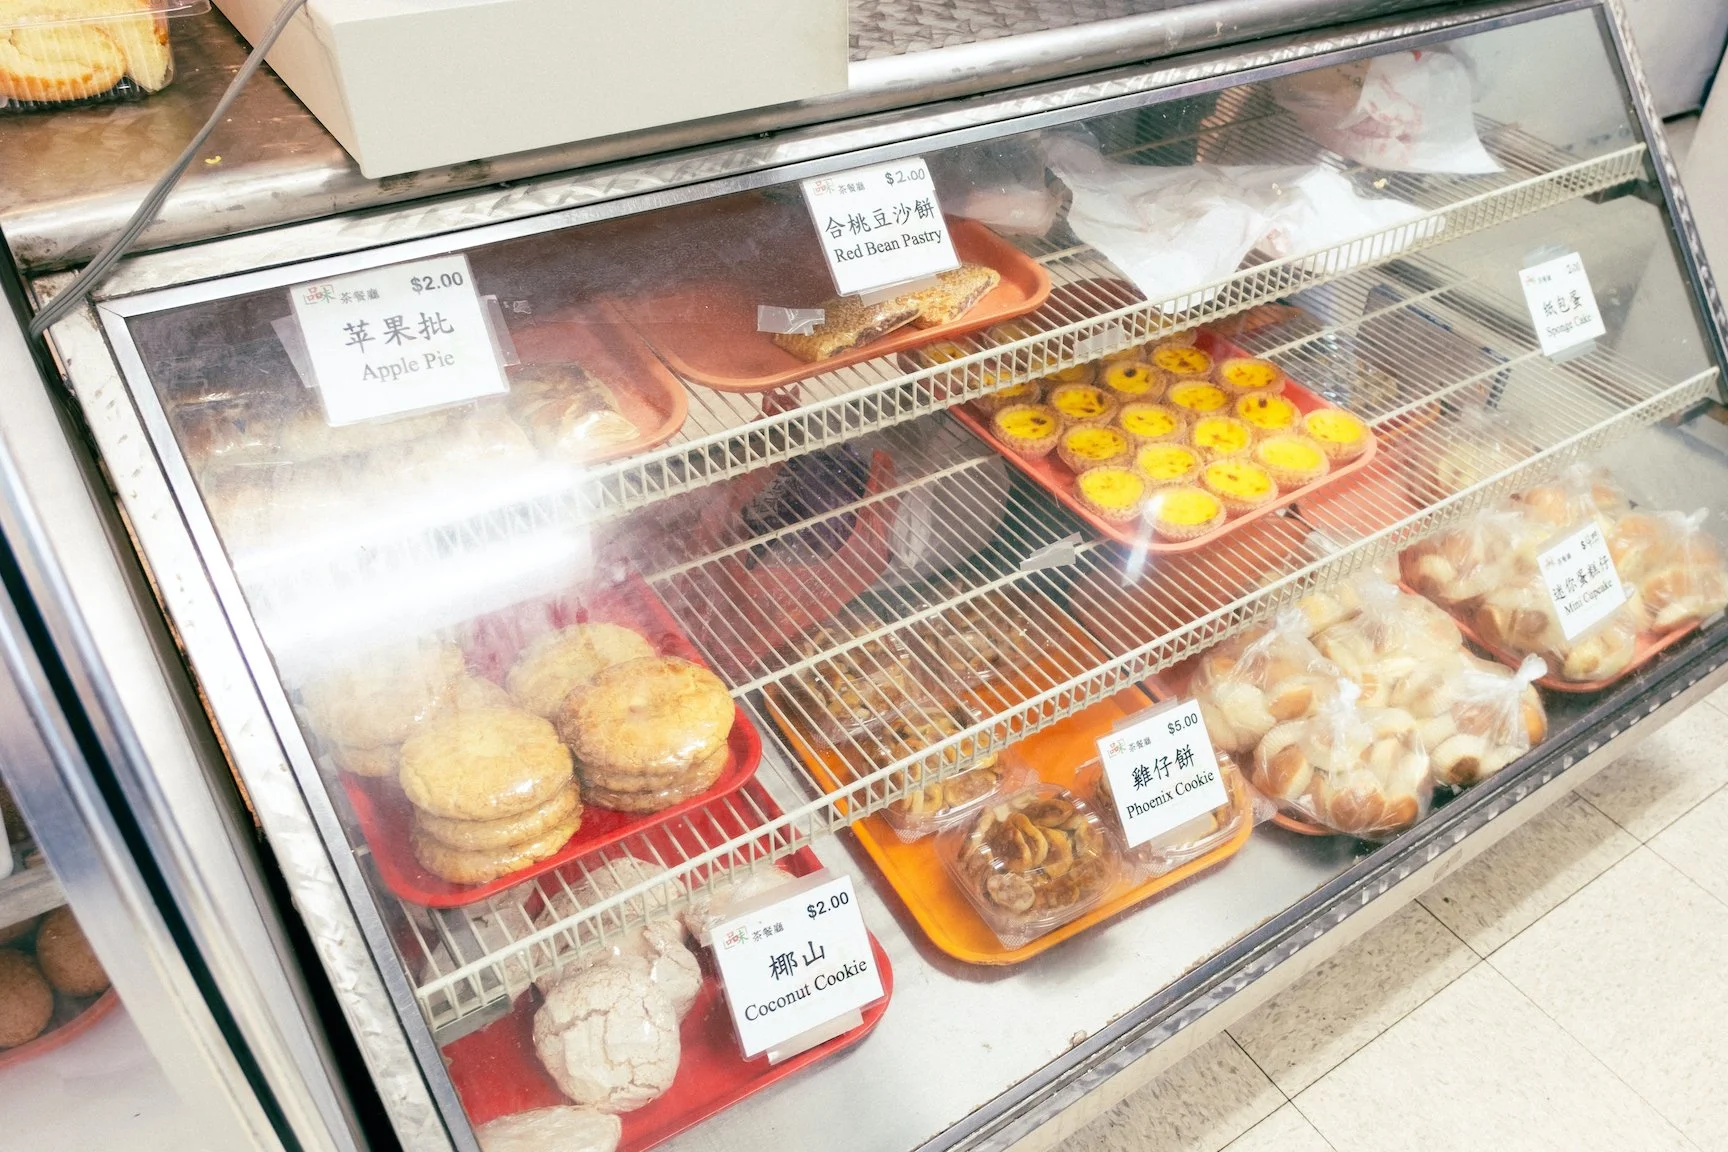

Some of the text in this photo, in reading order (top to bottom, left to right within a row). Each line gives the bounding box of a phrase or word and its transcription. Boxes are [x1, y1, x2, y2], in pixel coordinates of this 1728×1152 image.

[884, 168, 925, 186] $2.00
[825, 197, 935, 240] 合桃豆沙餅
[834, 229, 942, 263] Red Bean Pastry
[410, 271, 463, 295] $2.00
[342, 311, 455, 353] 苹果批
[1545, 315, 1592, 338] Sponge Cake
[362, 350, 455, 382] Apple Pie
[1564, 579, 1613, 615] Mini Cupcake
[1167, 713, 1198, 736] $5.00
[1131, 744, 1195, 792] 雞仔餅
[1126, 770, 1215, 820] Phoenix Cookie
[807, 891, 849, 920] $2.00
[768, 940, 826, 982] 椰山
[744, 959, 868, 1022] Coconut Cookie
